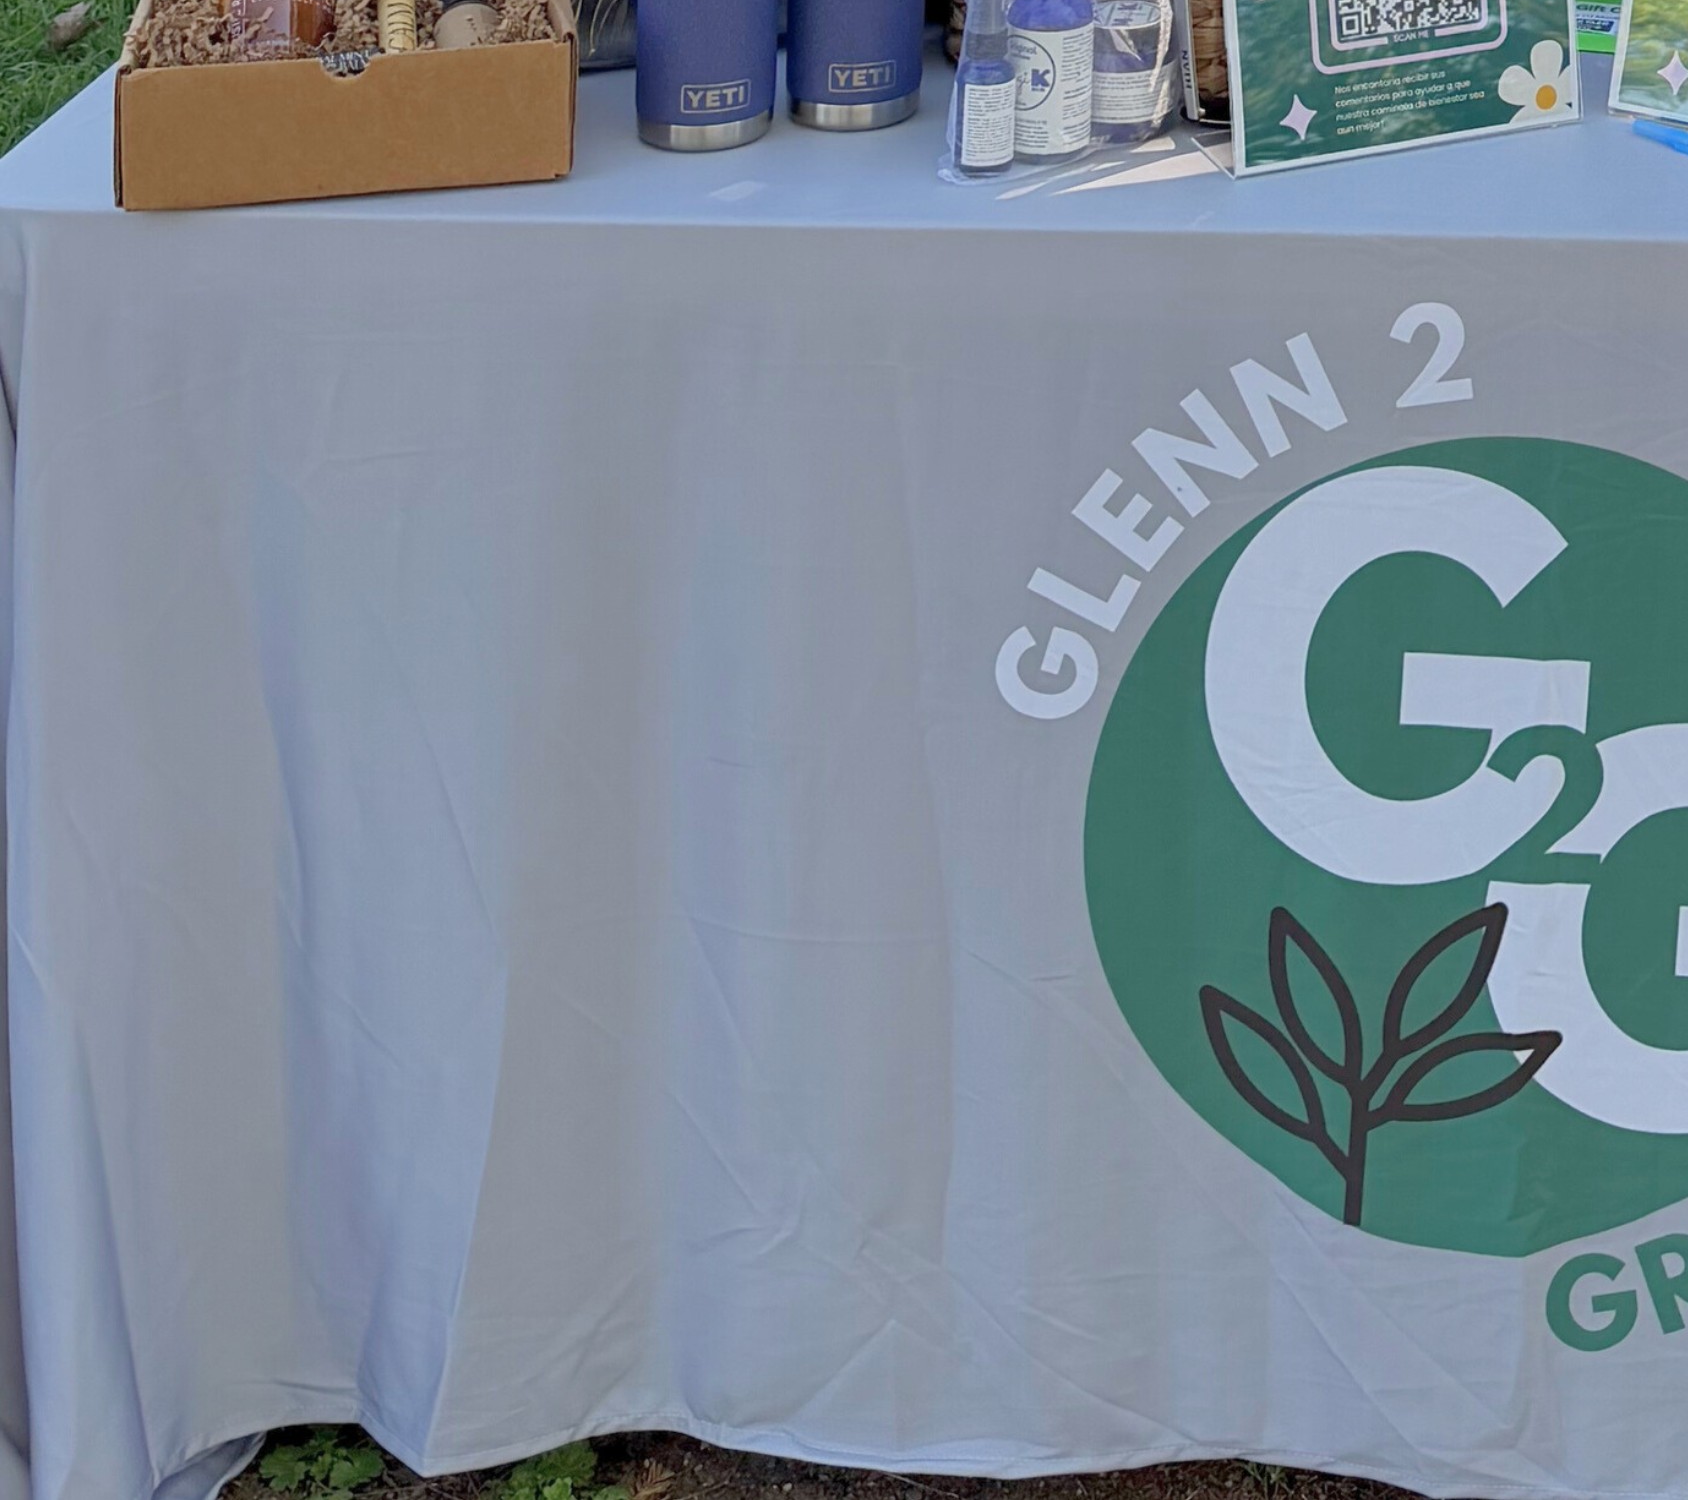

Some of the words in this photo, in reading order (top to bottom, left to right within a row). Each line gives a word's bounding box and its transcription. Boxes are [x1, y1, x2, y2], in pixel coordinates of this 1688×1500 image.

[834, 67, 892, 88] YETI
[686, 86, 745, 109] YETI
[995, 332, 1347, 719] GLENN
[1390, 302, 1474, 408] 2
